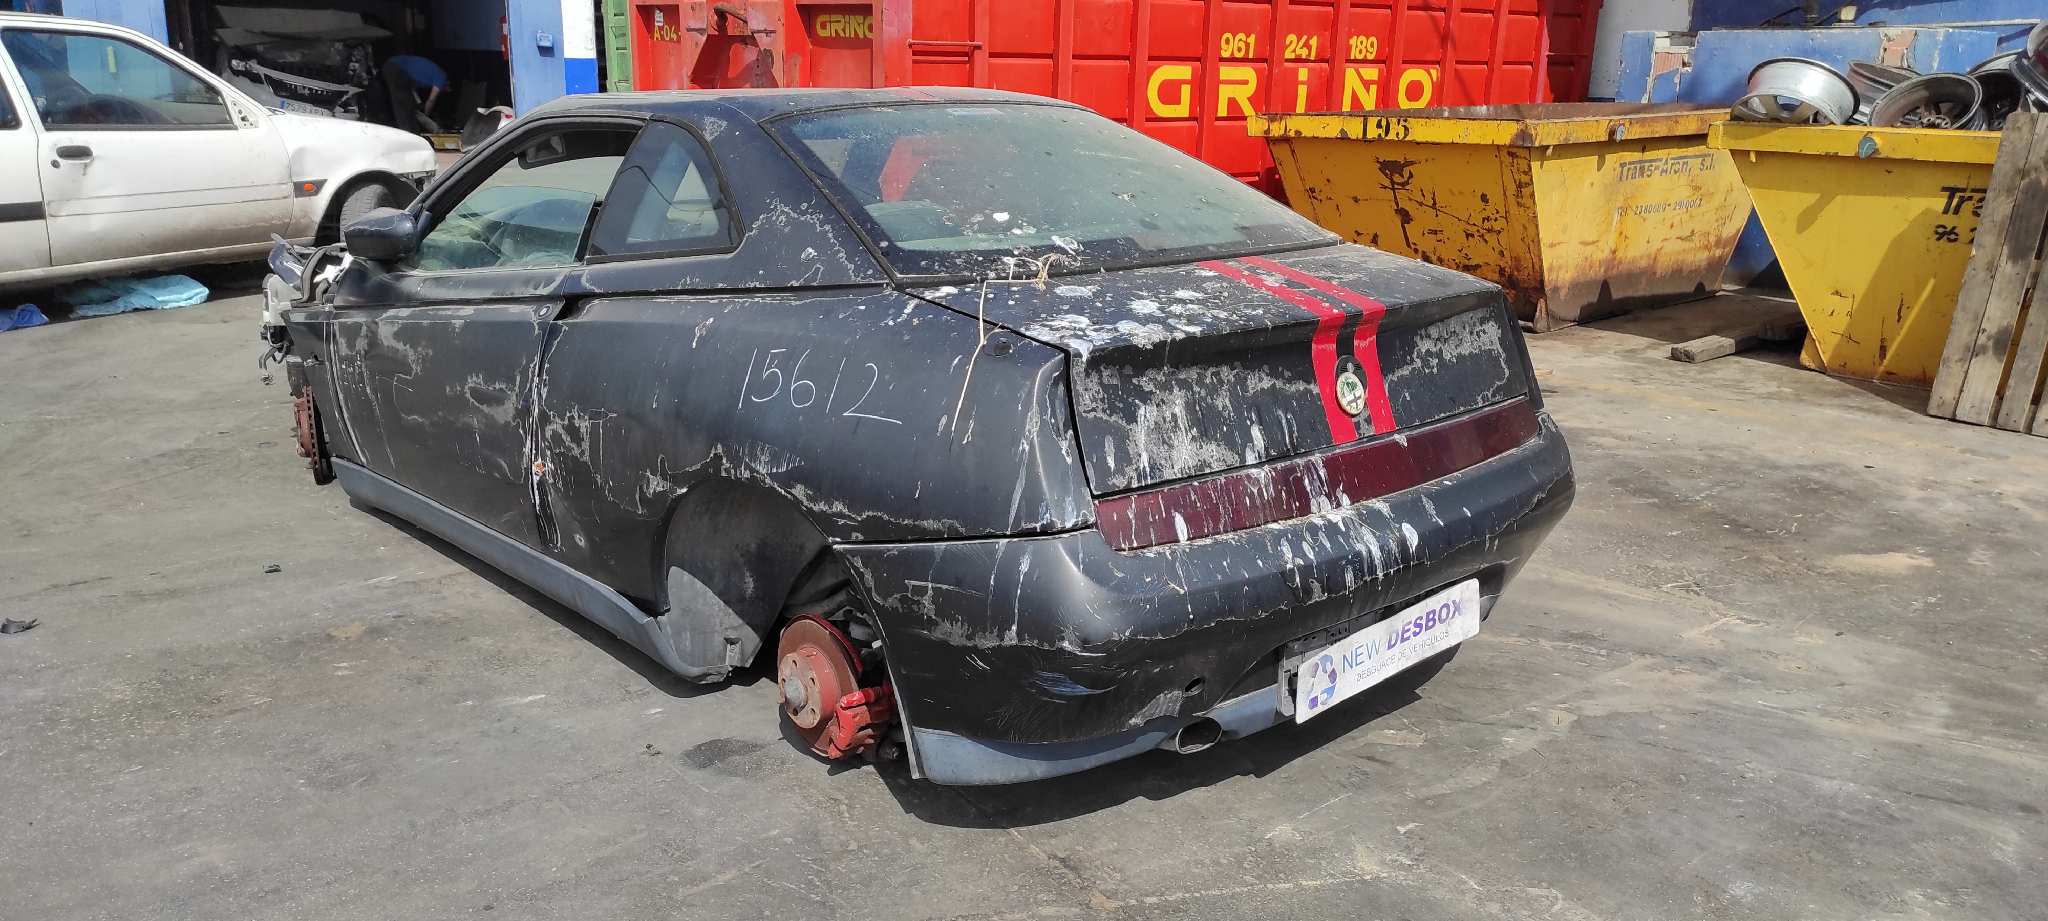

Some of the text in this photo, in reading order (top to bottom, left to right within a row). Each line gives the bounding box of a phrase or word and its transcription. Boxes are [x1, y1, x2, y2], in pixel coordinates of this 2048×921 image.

[1220, 32, 1378, 60] 961 241 189
[1934, 224, 1959, 243] 96
[738, 347, 902, 424] 15612
[1342, 599, 1464, 673] NEW DESBOX
